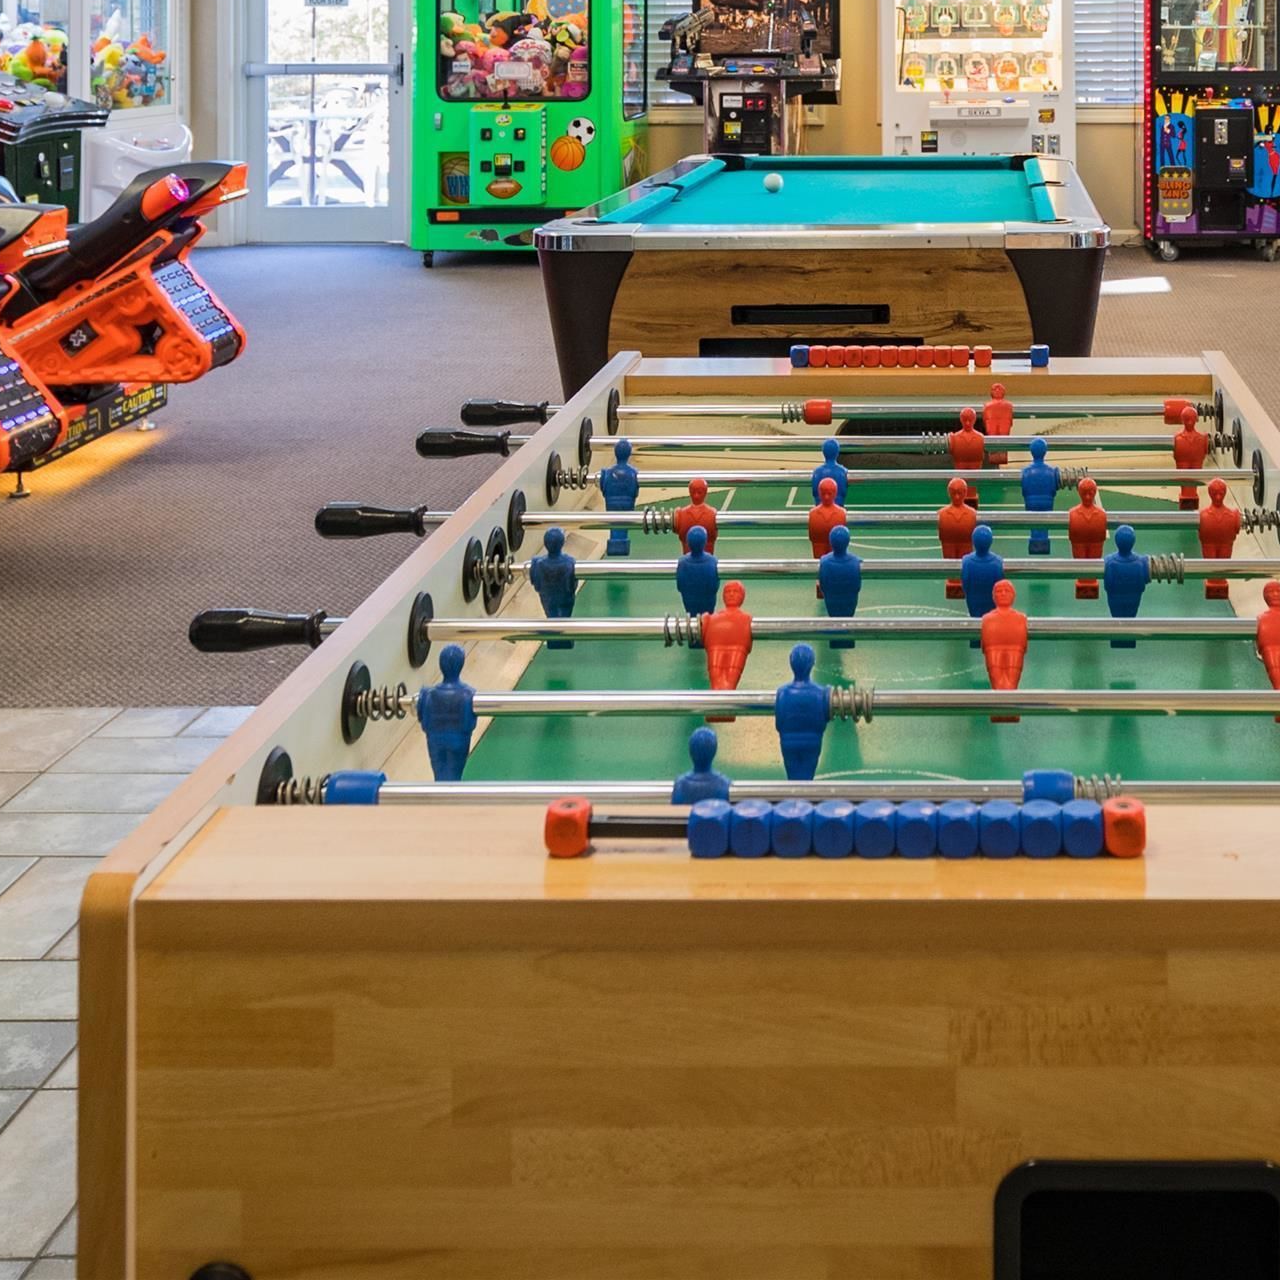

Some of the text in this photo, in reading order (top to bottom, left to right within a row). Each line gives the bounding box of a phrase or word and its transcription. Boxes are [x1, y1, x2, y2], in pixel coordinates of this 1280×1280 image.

[1159, 180, 1192, 191] BLING
[1161, 190, 1190, 200] KING
[122, 387, 156, 412] CAUTION
